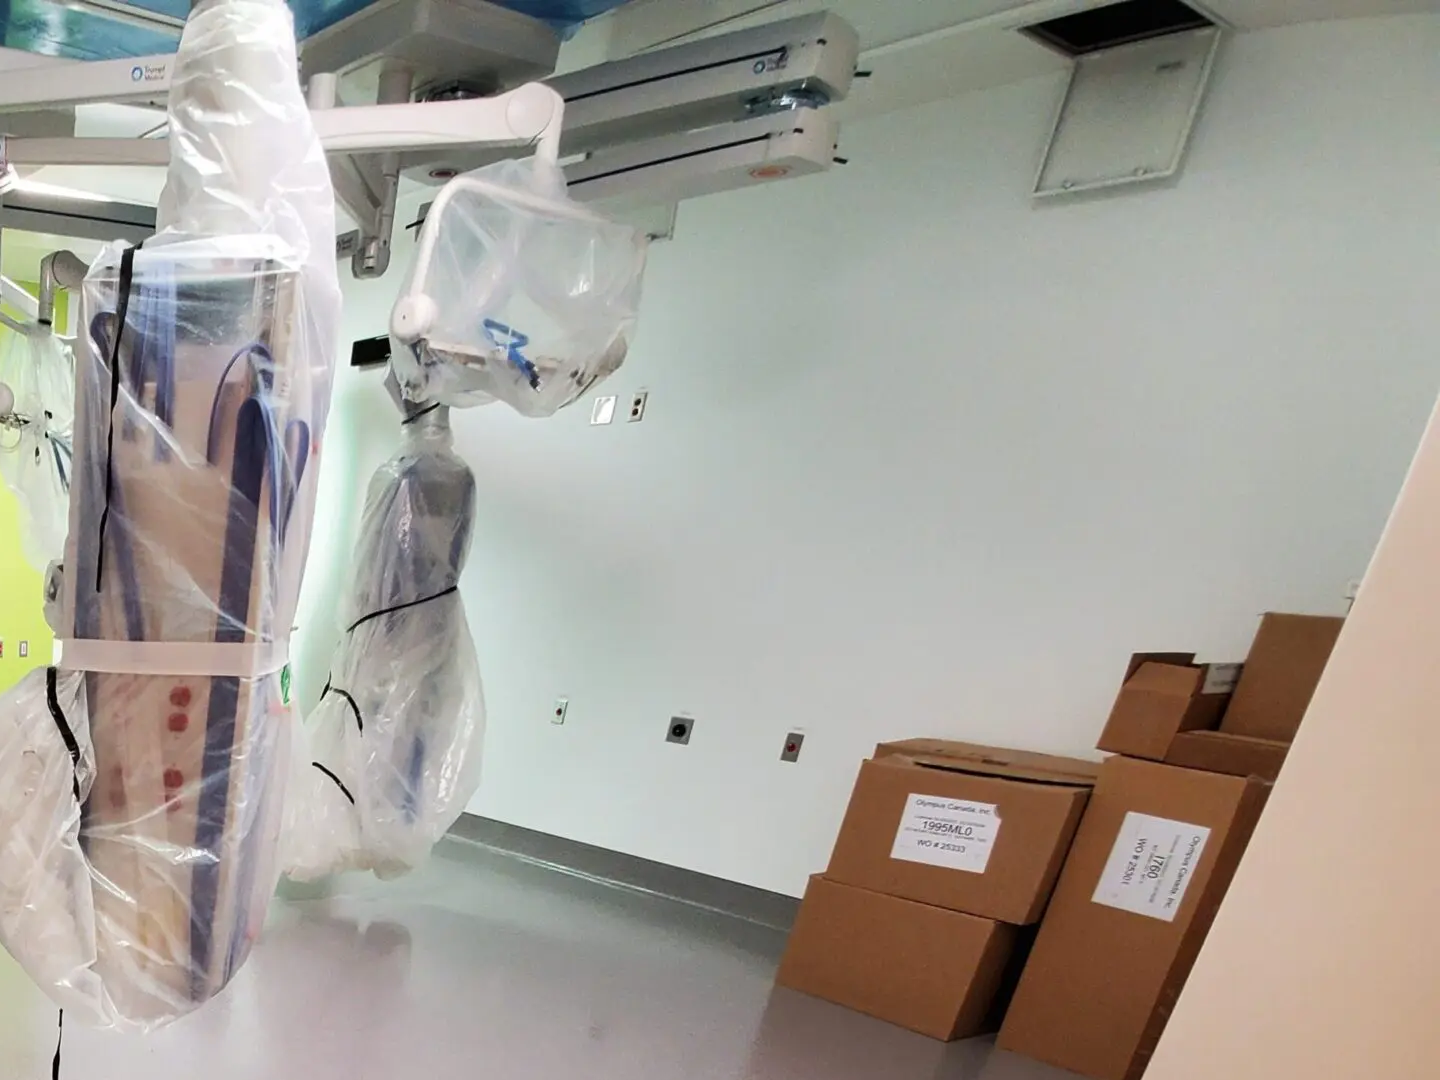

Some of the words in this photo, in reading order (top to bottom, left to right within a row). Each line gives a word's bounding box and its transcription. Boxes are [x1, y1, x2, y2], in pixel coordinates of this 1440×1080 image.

[917, 839, 932, 848] WO
[1134, 838, 1148, 853] WO
[1182, 835, 1201, 866] Olympus
[1120, 861, 1137, 885] 25301
